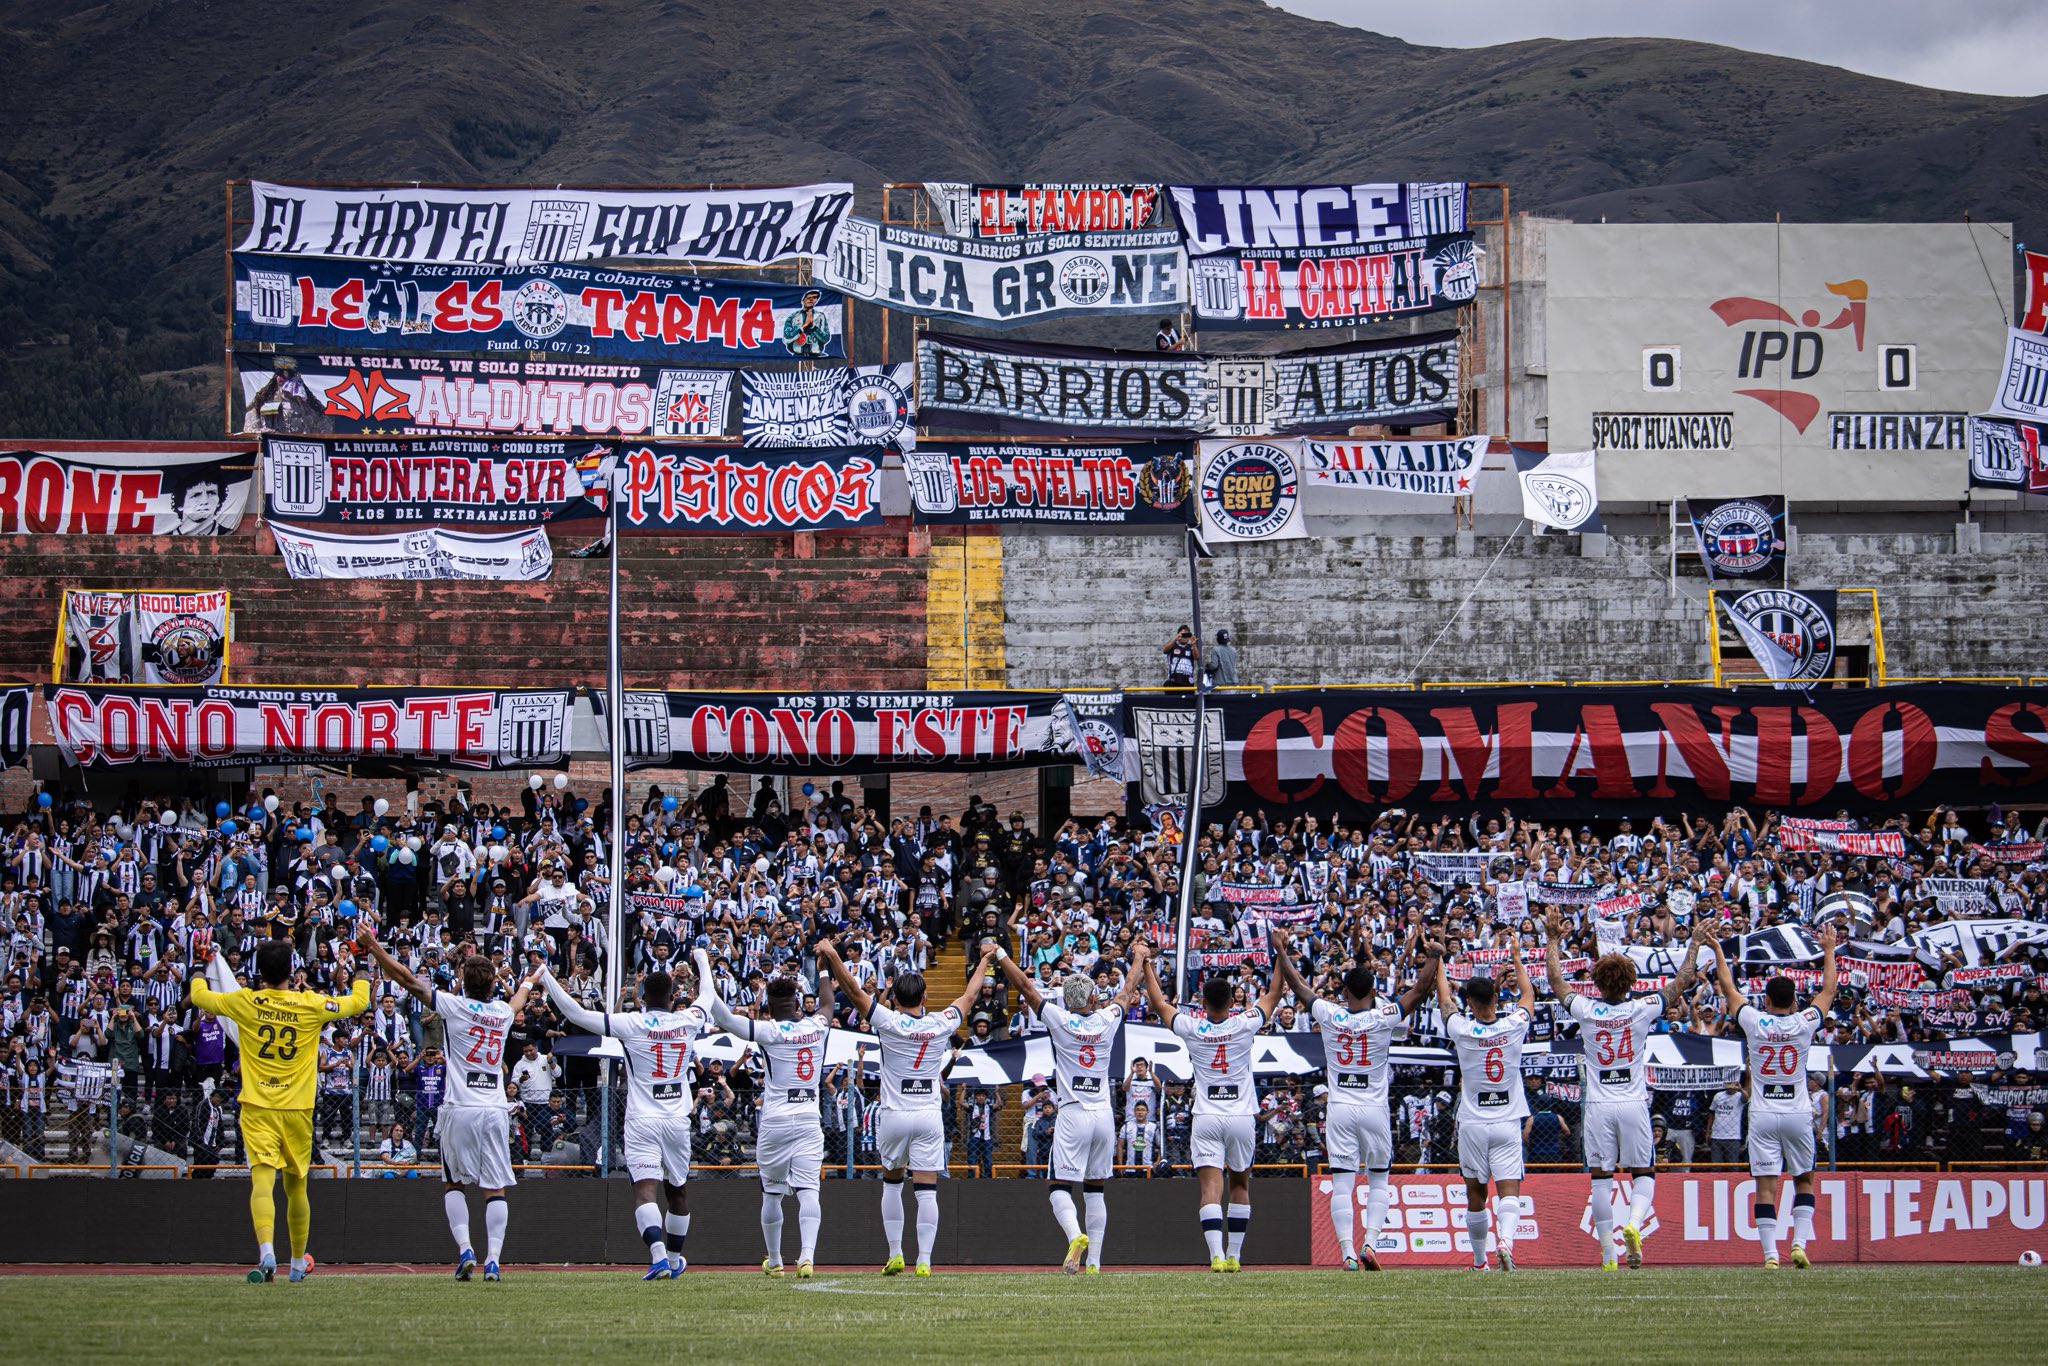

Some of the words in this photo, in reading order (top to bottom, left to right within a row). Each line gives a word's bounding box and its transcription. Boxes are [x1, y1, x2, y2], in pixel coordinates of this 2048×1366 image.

[977, 188, 1016, 237] EL
[1021, 188, 1125, 234] TAMBO
[1170, 183, 1400, 255] LINCE
[251, 194, 309, 252] EL
[323, 194, 515, 266] CÁRTEL
[587, 203, 691, 259] SAN
[886, 228, 958, 253] DISTINTOS
[963, 240, 1020, 260] BARRIOS
[1025, 241, 1046, 256] VN
[1047, 233, 1082, 250] SOLO
[1084, 231, 1179, 249] SENTIMIENTO
[1241, 249, 1282, 258] PEDACITO
[1286, 249, 1297, 258] DE
[1300, 248, 1328, 259] CIELO,
[1330, 245, 1365, 257] ALEGRIA
[1369, 244, 1384, 253] DEL
[411, 263, 447, 277] Este
[451, 266, 498, 277] amor
[550, 266, 590, 281] para
[594, 271, 674, 289] cobardes
[886, 250, 974, 313] ICA
[1240, 260, 1287, 319] LA
[1297, 249, 1432, 319] CAPITAL
[521, 281, 560, 300] LEALES
[297, 275, 503, 335] LEALES
[580, 285, 775, 350] TARMA
[515, 312, 539, 335] TARMA
[1310, 317, 1368, 329] JAUJA
[487, 340, 521, 351] Fund.
[525, 339, 539, 350] 05
[575, 343, 591, 355] 22
[1738, 330, 1824, 380] IPD
[319, 355, 355, 368] VNA
[361, 356, 403, 369] SOLA
[409, 358, 444, 373] VOZ,
[450, 360, 473, 373] VN
[479, 361, 519, 375] SOLO
[524, 362, 641, 379] SENTIMIENTO
[667, 371, 724, 382] MALDITOS
[754, 380, 782, 392] VILLA
[784, 382, 796, 392] EL
[934, 349, 1190, 420] BARRIOS
[1293, 348, 1450, 417] ALTOS
[750, 386, 848, 423] AMENAZA
[859, 400, 887, 415] SAN
[1265, 379, 1275, 413] LIMA
[655, 388, 669, 429] BARRA
[763, 417, 836, 438] GRONE
[854, 414, 893, 430] PEDRO
[1230, 425, 1256, 436] 1901
[1593, 415, 1642, 449] SPORT
[1645, 415, 1732, 449] HUANCAYO
[1830, 415, 1966, 450] ALIANZA
[334, 442, 350, 452] LA
[353, 443, 397, 453] RIVERA
[412, 442, 427, 452] EL
[429, 442, 489, 454] AGVSTINO
[502, 443, 533, 454] CONO
[536, 443, 565, 454] ESTE
[969, 447, 998, 457] RIVA
[1051, 448, 1065, 457] EL
[1310, 440, 1476, 473] SALVAJES
[1207, 450, 1239, 482] RIVA
[328, 456, 496, 505] FRONTERA
[504, 458, 568, 505] SVR
[952, 456, 1008, 509] LOS
[1011, 456, 1136, 510] SVELTOS
[1223, 474, 1275, 493] CONO
[1335, 471, 1358, 484] LA
[1363, 471, 1456, 494] VICTORIA
[1223, 491, 1273, 510] ESTE
[356, 508, 385, 520] LOS
[396, 508, 423, 519] DEL
[433, 508, 537, 522] EXTRANJERO
[970, 510, 983, 520] DE
[985, 510, 1000, 520] LA
[1035, 509, 1071, 521] HASTA
[1075, 511, 1086, 521] EL
[1213, 509, 1226, 526] EL
[1711, 508, 1749, 535] ALBOROTO
[1750, 515, 1768, 533] SVR
[411, 540, 429, 551] TC
[1717, 554, 1740, 567] SANTA
[207, 689, 292, 703] COMANDO
[300, 690, 338, 703] SVR
[507, 694, 558, 707] ALIANZA
[778, 696, 819, 708] LOS
[823, 696, 850, 708] DE
[853, 695, 954, 709] SIEMPRE
[53, 687, 238, 768] CONO
[260, 690, 497, 769] NORTE
[551, 716, 562, 748] LIMA
[657, 716, 666, 747] LIMA
[689, 703, 856, 768] CONO
[873, 703, 1029, 765] ESTE
[273, 753, 359, 767] EXTRANJERO
[1141, 738, 1153, 778] CLUB
[1209, 741, 1221, 776] LIMA
[1241, 699, 1938, 804] COMANDO
[1837, 831, 1905, 859] CHICLAYO
[632, 894, 661, 909] CONO
[664, 897, 686, 915] SVR
[256, 1008, 299, 1023] VISCARRA
[1595, 1017, 1633, 1029] GUERRERO
[257, 1024, 298, 1061] 23
[647, 1028, 688, 1040] ADVINCULA
[792, 1033, 820, 1045] CASTILLO
[909, 1032, 936, 1042] GAIBOR
[1203, 1034, 1233, 1044] CHAVEZ
[1767, 1031, 1791, 1043] VÉLEZ
[465, 1025, 502, 1067] 25
[913, 1041, 928, 1069] 7
[1078, 1044, 1097, 1069] 3
[1336, 1033, 1372, 1067] 31
[1595, 1027, 1635, 1067] 34
[650, 1042, 688, 1079] 17
[797, 1047, 814, 1082] 8
[1210, 1044, 1230, 1075] 4
[1485, 1047, 1505, 1083] 6
[1546, 1055, 1576, 1065] SVR
[1758, 1045, 1798, 1076] 20
[1927, 1051, 1942, 1066] LA
[1945, 1051, 1997, 1067] PARADITA
[1525, 1067, 1542, 1077] DE
[1549, 1067, 1577, 1078] ATE
[1600, 1076, 1630, 1084] ANYPSA
[468, 1081, 497, 1089] ANYPSA
[653, 1091, 682, 1100] ANYPSA
[902, 1086, 932, 1094] ANYPSA
[1209, 1092, 1239, 1100] ANYPSA
